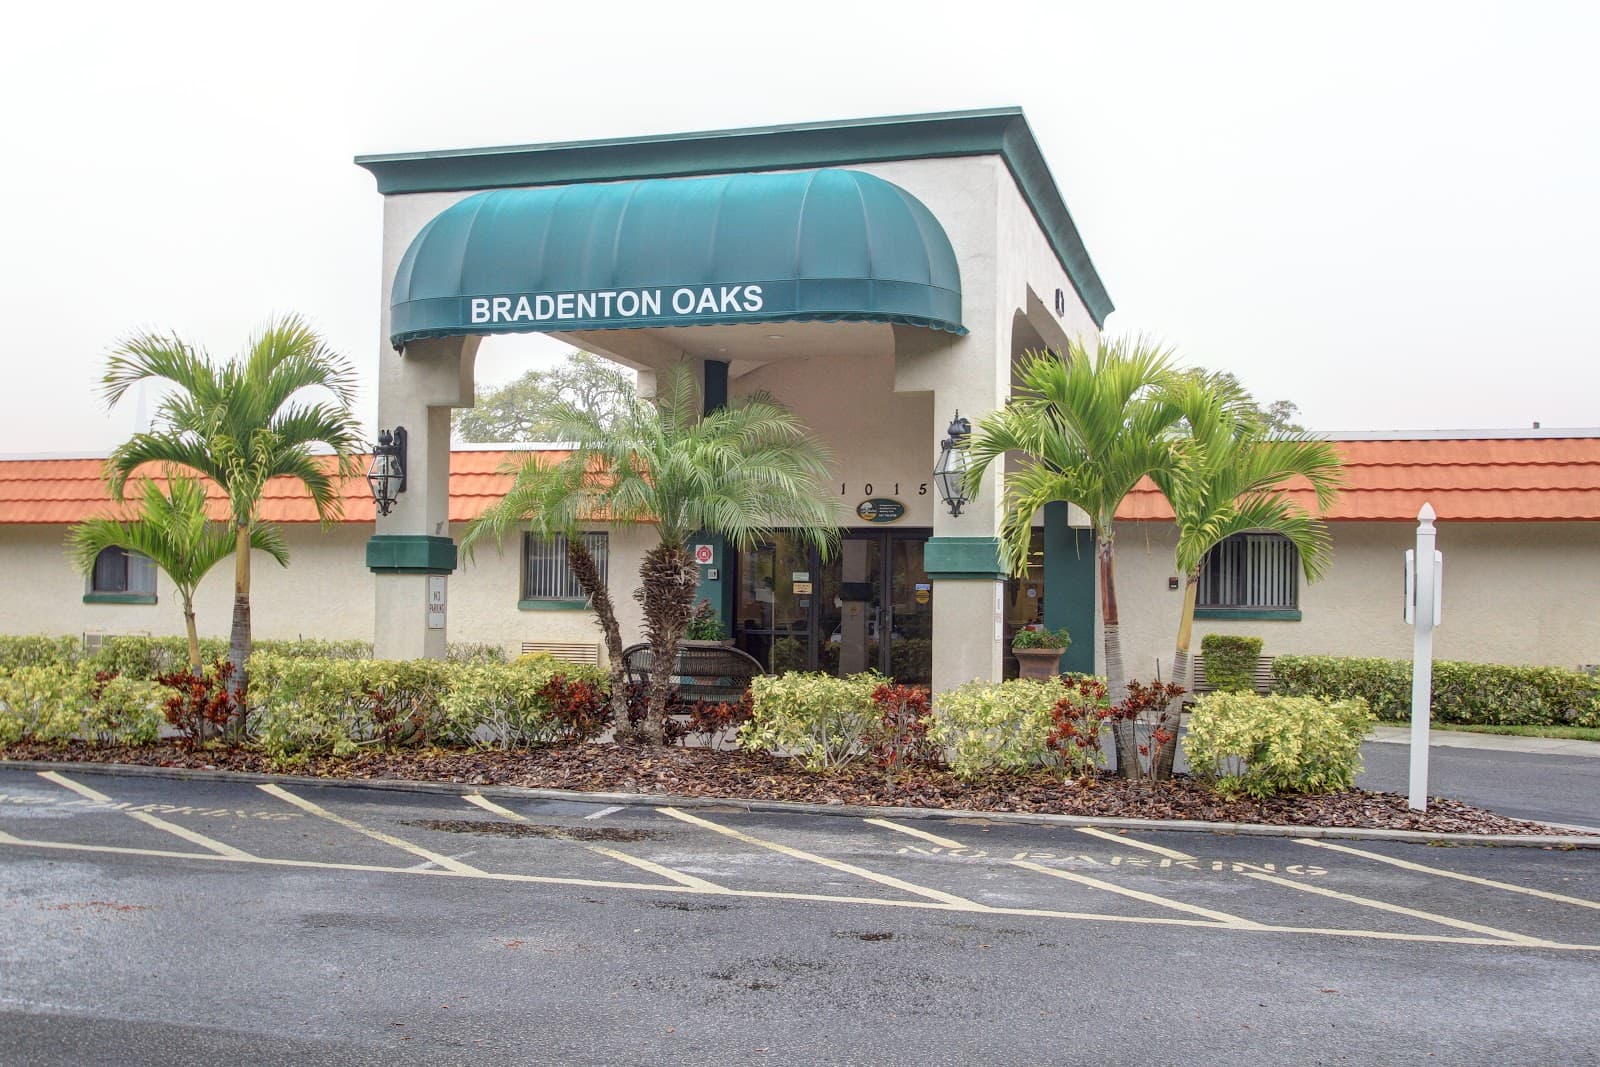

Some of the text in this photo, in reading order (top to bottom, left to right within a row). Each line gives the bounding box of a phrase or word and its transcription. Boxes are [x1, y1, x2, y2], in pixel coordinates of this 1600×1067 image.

[471, 285, 764, 324] BRADENTON OAKS
[896, 845, 1329, 876] NO PARKING
